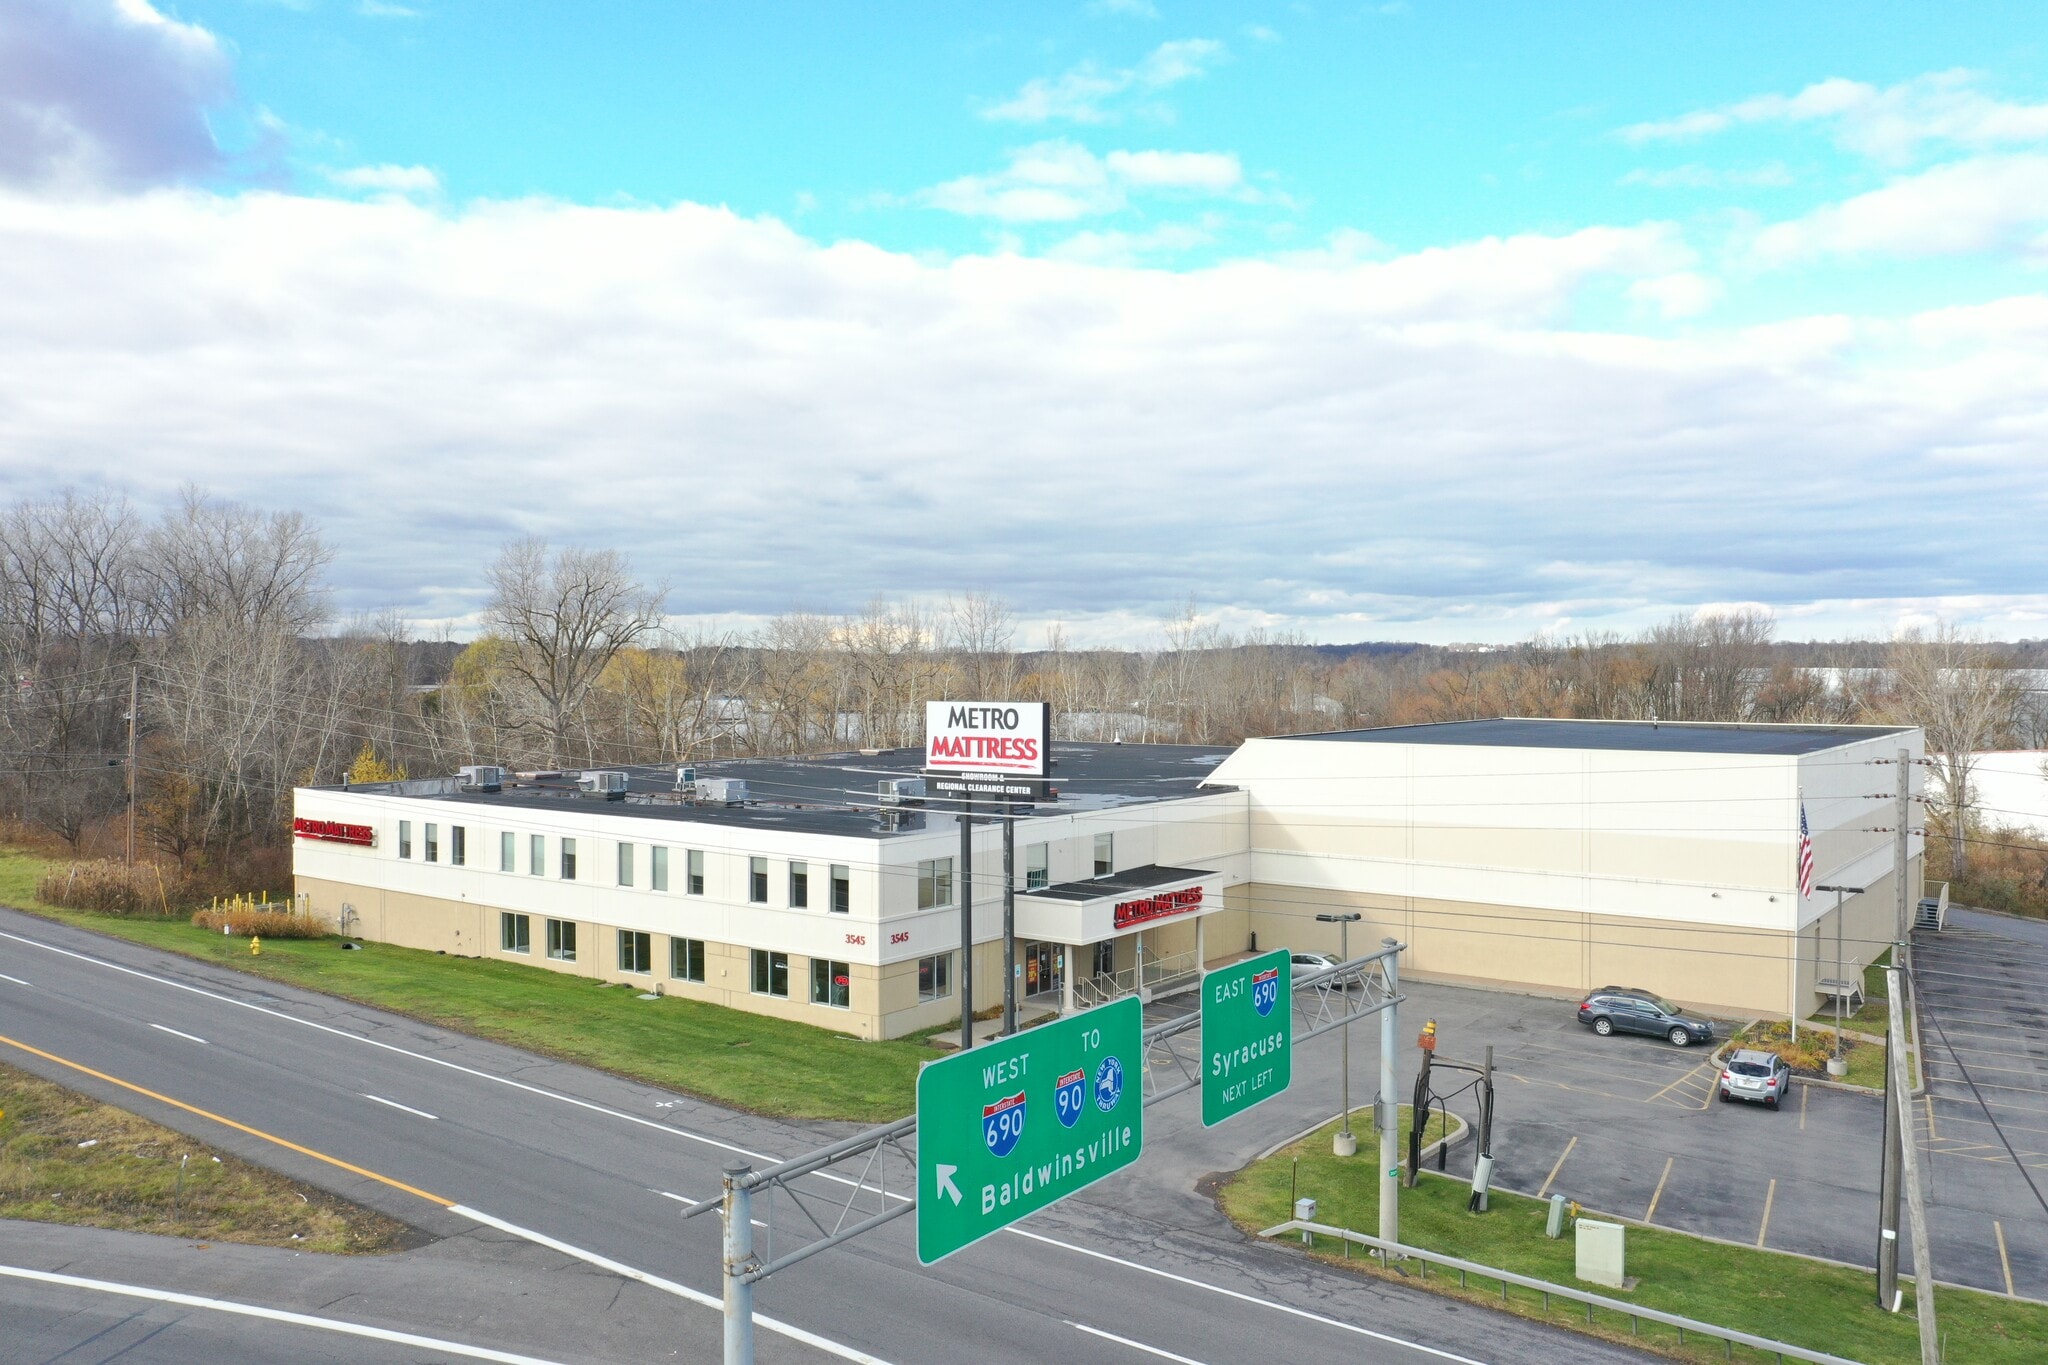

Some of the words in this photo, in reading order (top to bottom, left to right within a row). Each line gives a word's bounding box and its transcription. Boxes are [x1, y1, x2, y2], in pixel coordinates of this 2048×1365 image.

[948, 705, 1019, 730] METRO
[931, 736, 1038, 761] MATTRESS
[936, 782, 967, 791] REGIONAL
[967, 783, 1005, 793] CLEARANCE
[1005, 785, 1031, 795] CENTER
[961, 772, 998, 782] SHOWROOM
[294, 817, 326, 834] METRO
[325, 821, 373, 840] MATTRESS
[1114, 898, 1153, 920] METRO
[845, 934, 866, 946] 3545
[890, 931, 909, 945] 3545
[1215, 977, 1246, 1004] EAST
[1254, 981, 1277, 1007] 690
[1081, 1028, 1100, 1053] TO
[1212, 1031, 1283, 1078] Syracuse
[982, 1053, 1030, 1090] WEST
[1222, 1080, 1248, 1105] NEXT
[1251, 1067, 1273, 1091] LEFT
[1059, 1085, 1081, 1116] 90
[986, 1109, 1023, 1147] 690
[981, 1125, 1132, 1215] Baldwinsville
